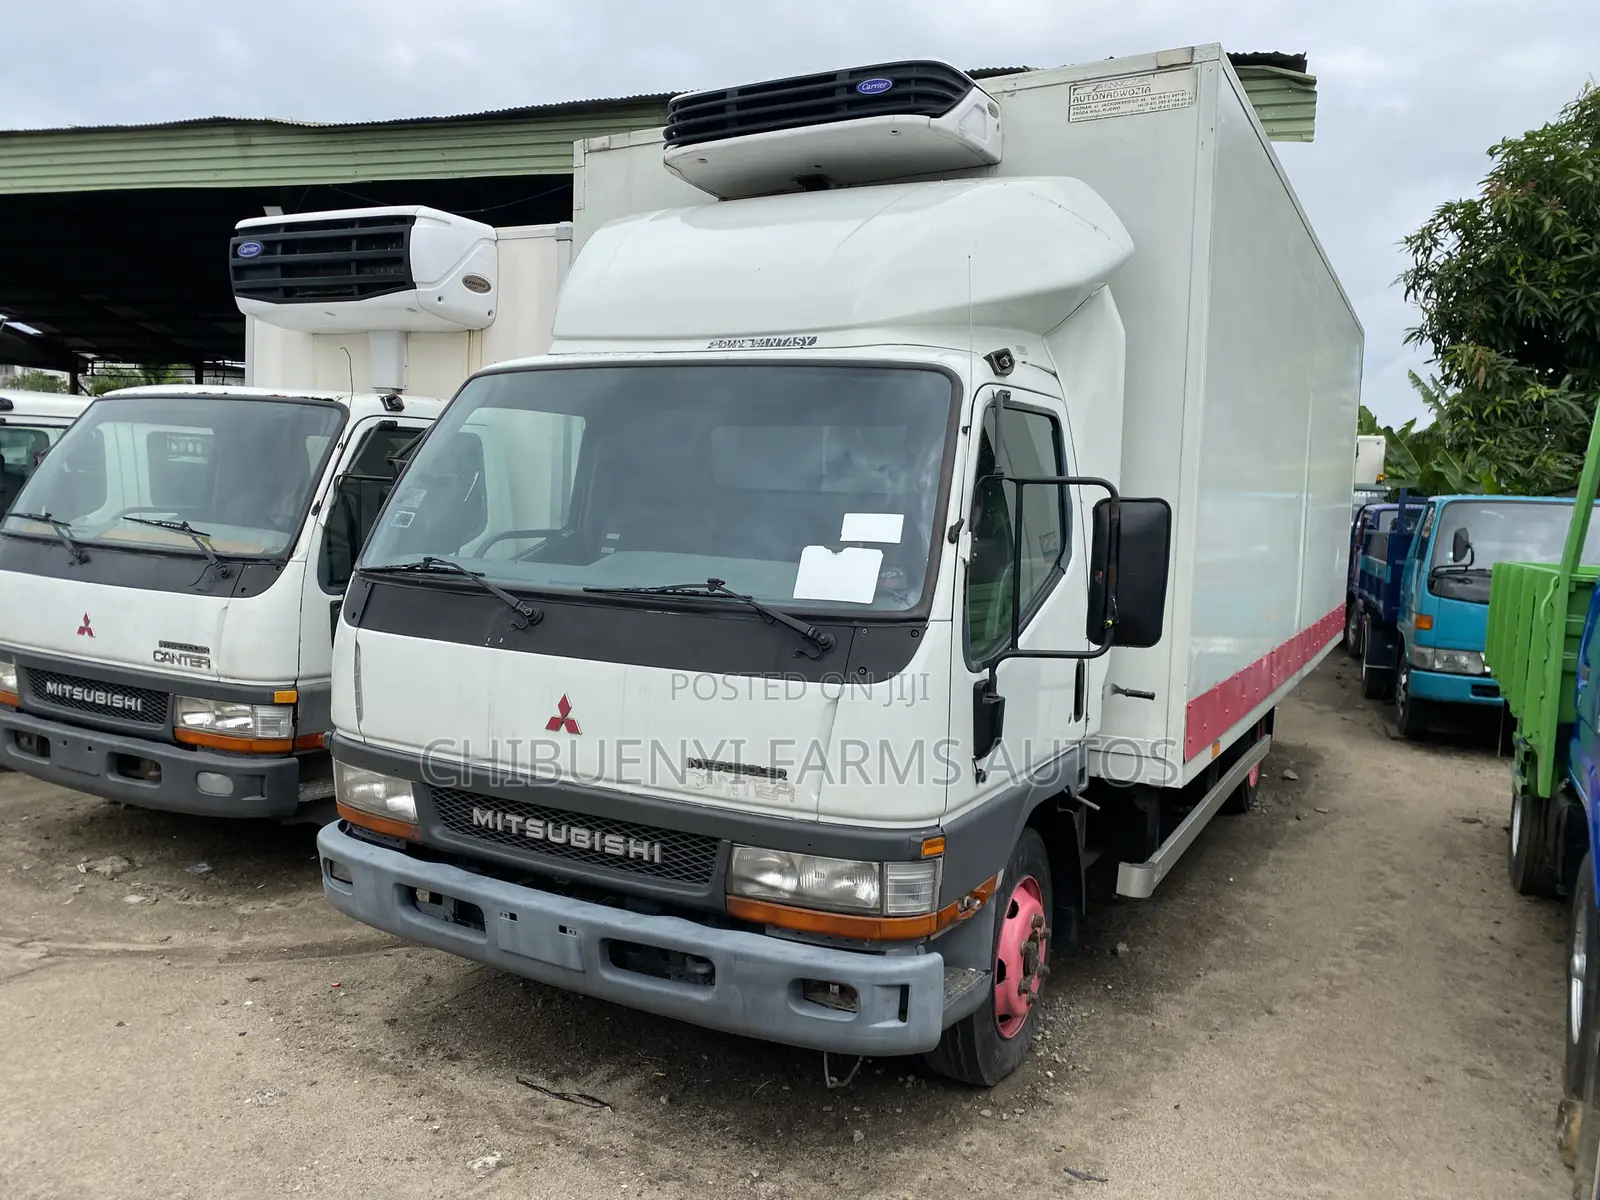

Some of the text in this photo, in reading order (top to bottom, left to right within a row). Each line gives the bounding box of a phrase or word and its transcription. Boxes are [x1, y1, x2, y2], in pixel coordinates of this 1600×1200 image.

[861, 82, 888, 91] Carrier
[1072, 86, 1152, 104] AUTONADWOZIA
[153, 650, 211, 669] CANTER
[46, 681, 142, 712] MITSUBISHI
[686, 757, 788, 781] INTERCOOLER
[472, 807, 664, 864] MITSUBISHI
